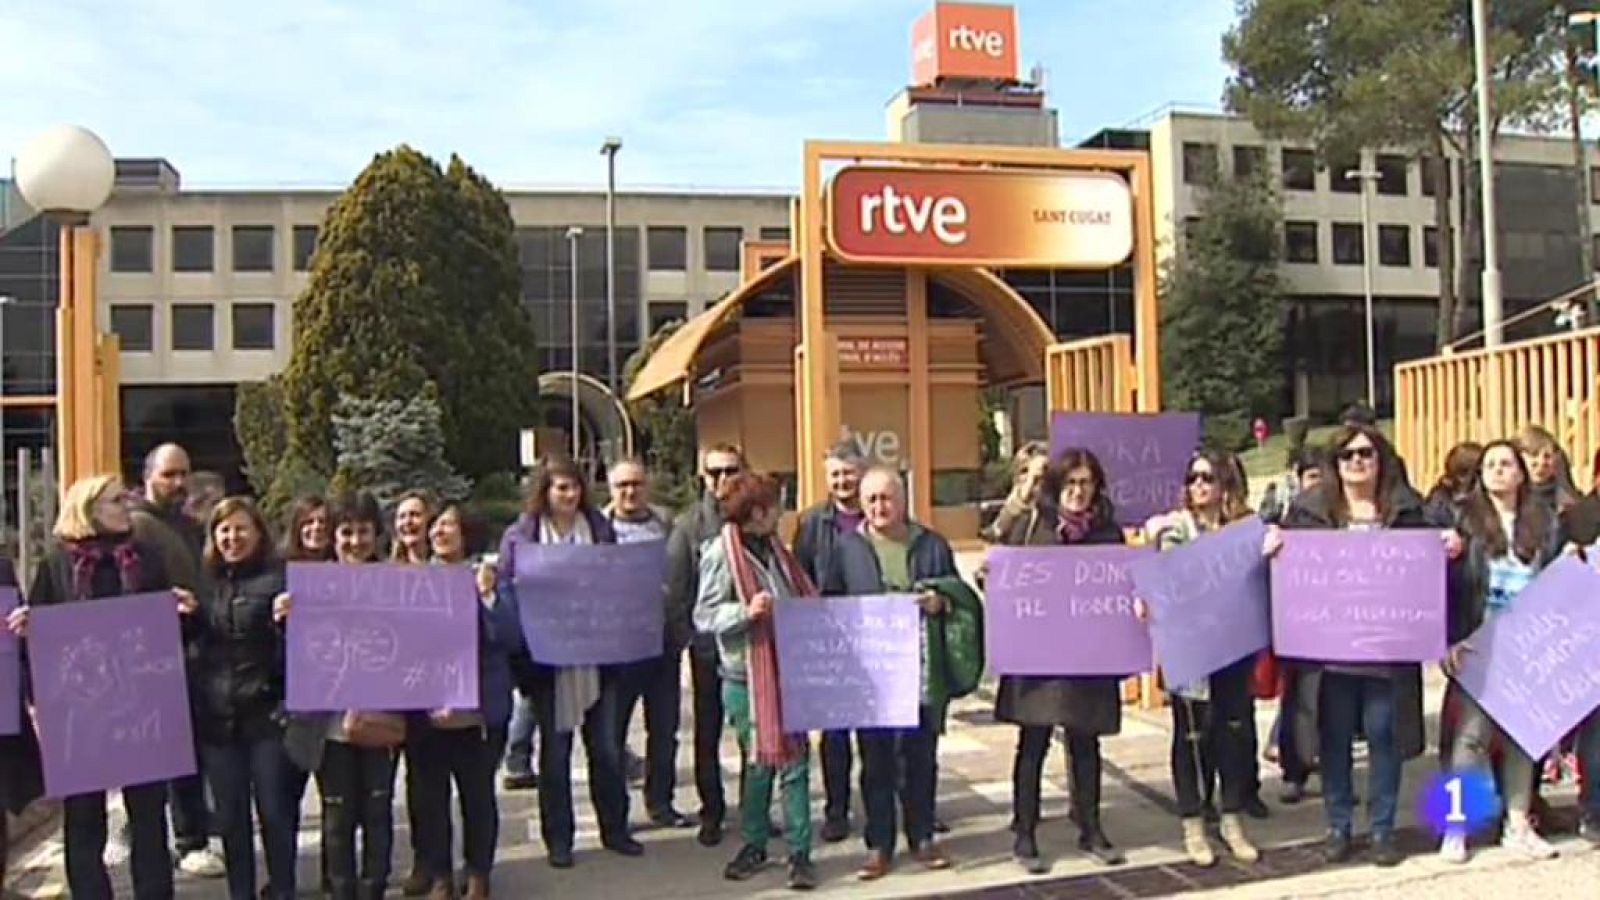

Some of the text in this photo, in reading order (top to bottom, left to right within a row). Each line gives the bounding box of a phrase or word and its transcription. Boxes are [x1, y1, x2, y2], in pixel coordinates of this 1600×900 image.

[949, 25, 1004, 56] rtve
[859, 185, 967, 244] rtve
[1033, 208, 1112, 225] SANT CUGAT
[998, 559, 1054, 588] LES
[1015, 598, 1048, 619] AL
